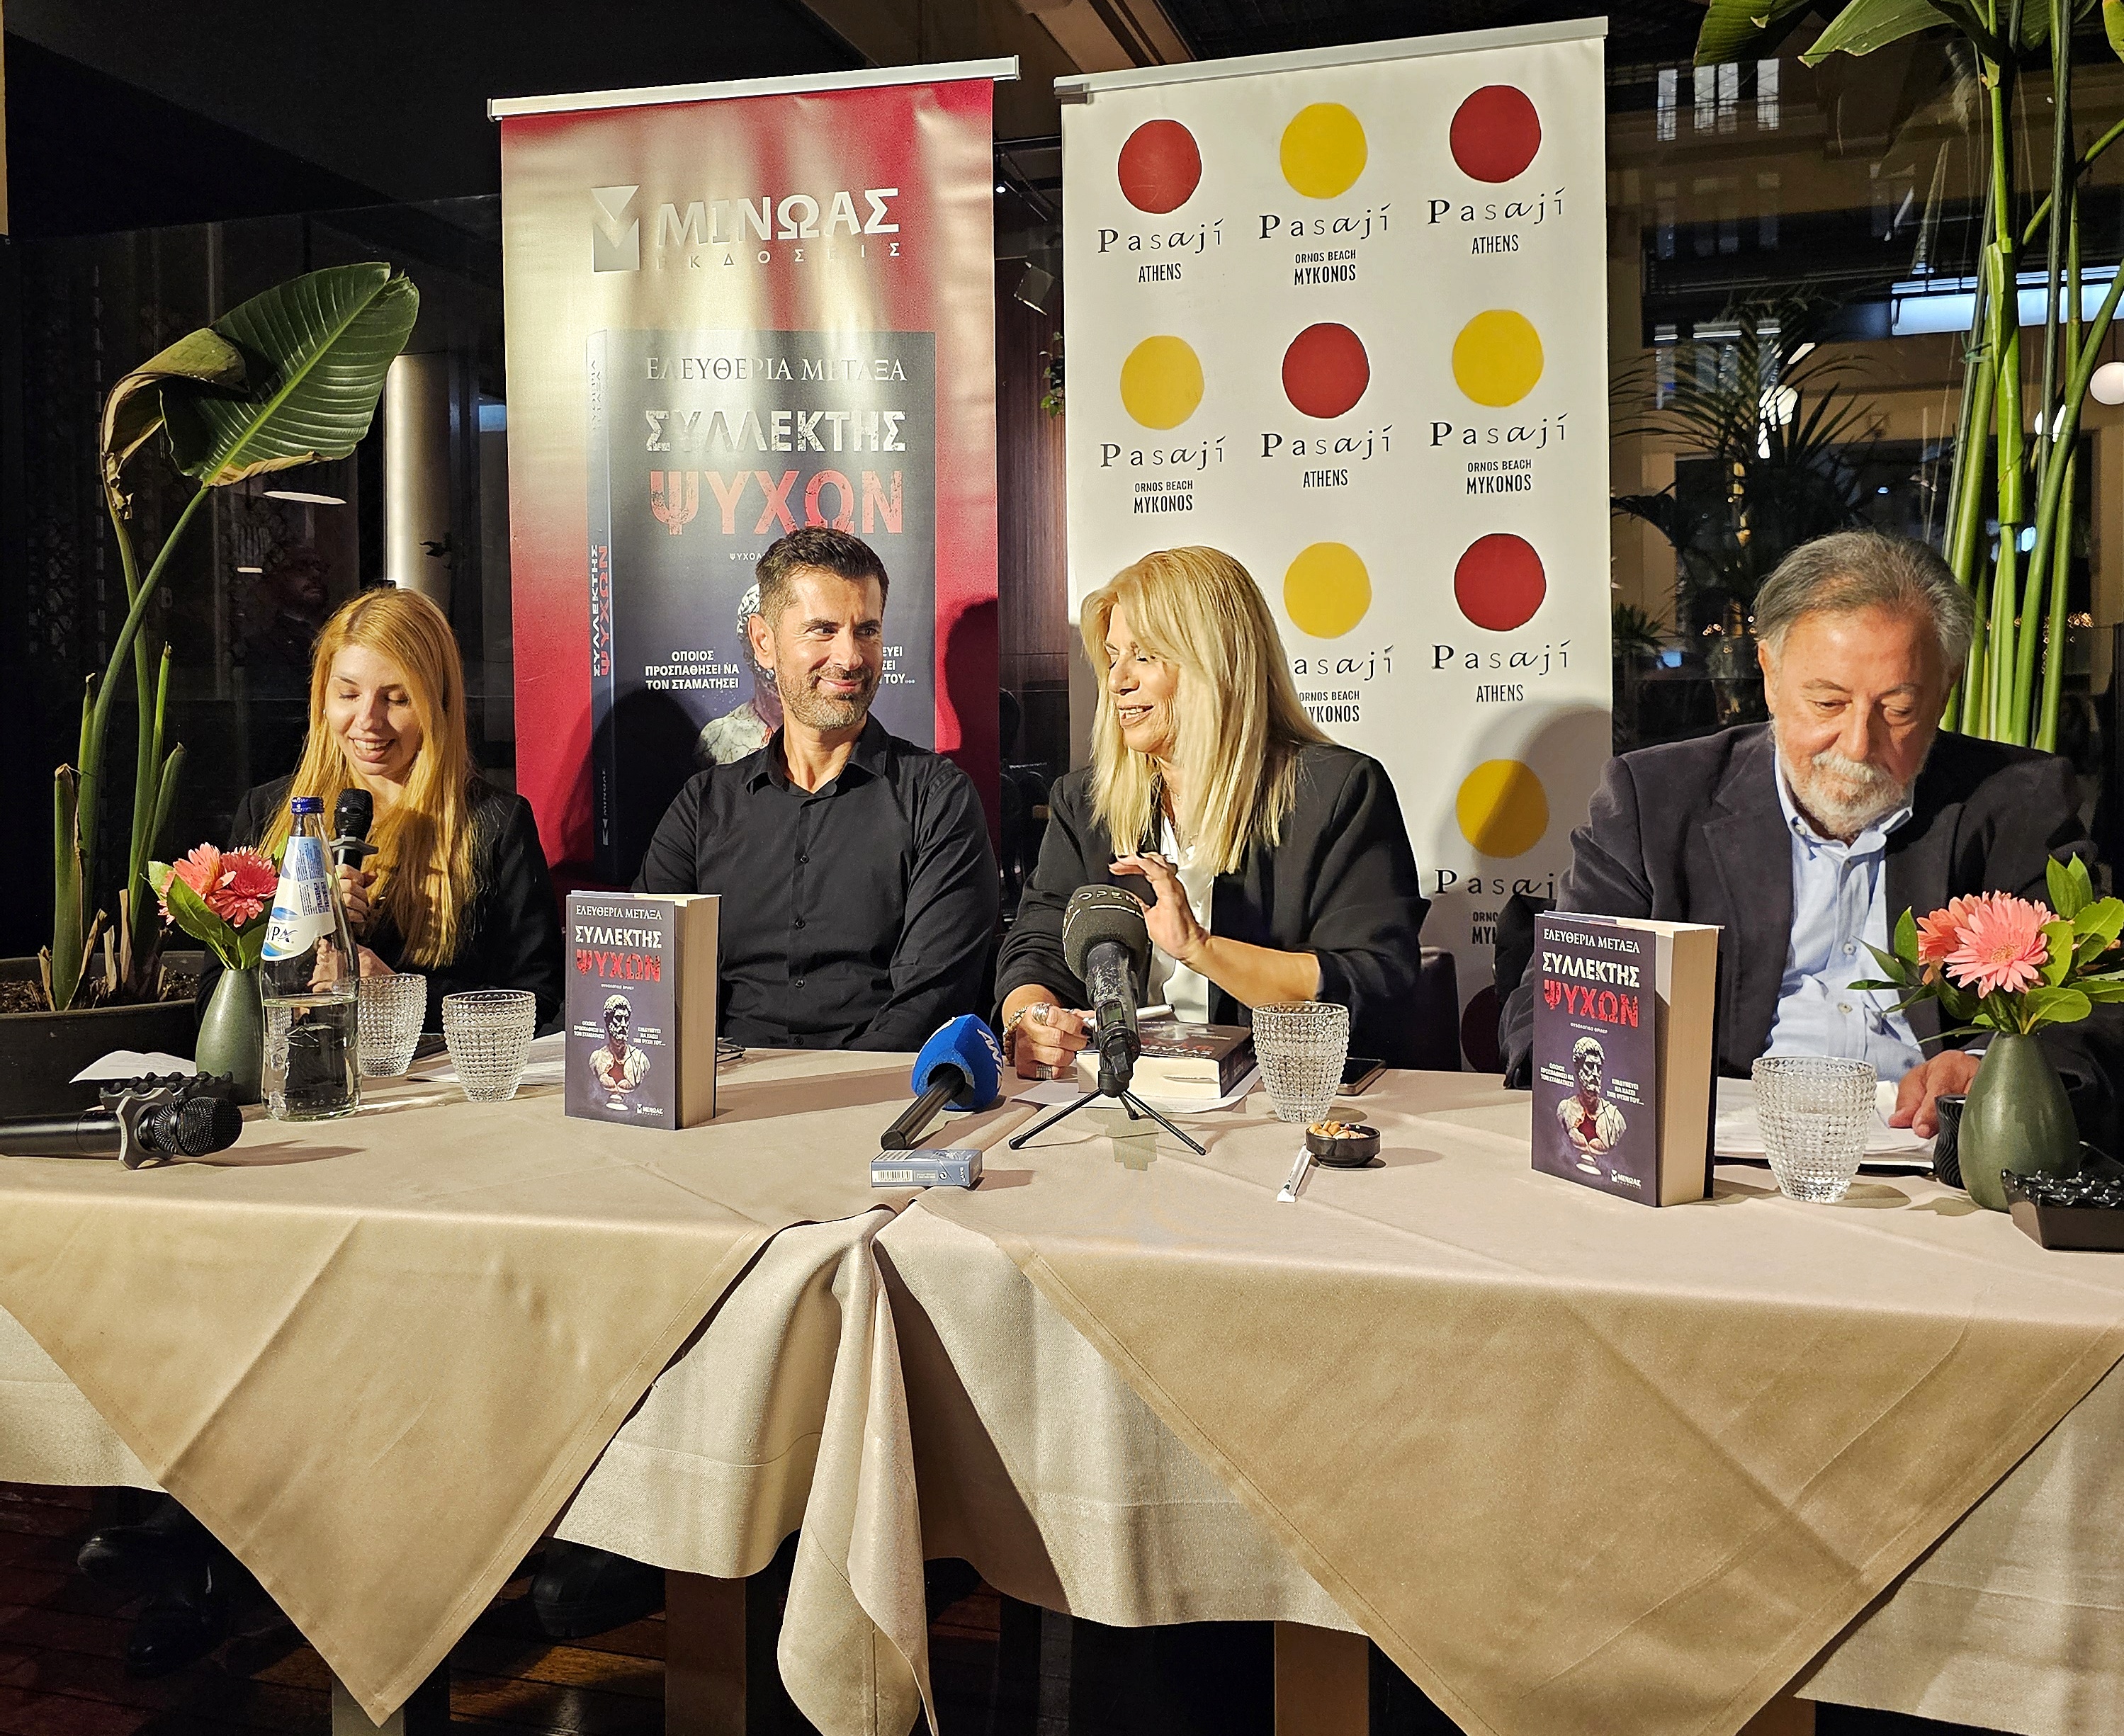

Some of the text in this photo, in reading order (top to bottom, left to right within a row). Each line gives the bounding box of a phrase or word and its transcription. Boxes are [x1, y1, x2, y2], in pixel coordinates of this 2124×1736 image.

[657, 188, 900, 246] ΜΙΝΩΑΣ
[1471, 234, 1519, 255] ATHENS
[657, 243, 900, 270] ΕΚΔΟΣΕΙΣ
[1295, 249, 1356, 264] ORNOS BEACH
[1138, 263, 1182, 283] ATHENS
[1294, 263, 1356, 286] MYKONOS
[645, 356, 908, 382] ΕΛΕΥΘΕΡΙΑ ΜΕΤΑΞΑ
[645, 409, 907, 452] ΣΥΛΛΕΚΤΗΣ
[1467, 458, 1532, 472] ORNOS BEACH
[1134, 480, 1193, 493] ORNOS BEACH
[1303, 469, 1348, 489] ATHENS
[1466, 474, 1532, 495] MYKONOS
[649, 470, 904, 535] ΨΥΧΩΝ
[1134, 494, 1193, 514] MYKONOS
[730, 552, 766, 561] ΨΥΧΟΛ
[591, 544, 601, 677] ΣΥΛΛΕΚΤΗΣ
[599, 545, 610, 676] ΨΥΧΩΝ
[671, 650, 714, 662] ΟΠΟΙΟΣ
[1294, 645, 1394, 681] asají
[645, 664, 740, 677] ΠΡΟΣΠΑΘΗΣΕΙ ΝΑ
[645, 678, 740, 691] ΤΟΝ ΣΤΑΜΑΤΗΣΕΙ
[1476, 683, 1524, 704] ATHENS
[1299, 690, 1360, 703] ORNOS BEACH
[1306, 705, 1360, 723] YKONOS
[575, 904, 662, 920] ΕΛΕΥΘΕΡΙΑ ΜΕΤΑΞΑ
[575, 925, 662, 949] ΣΥΛΛΕΚΤΗΣ
[1543, 928, 1641, 954] ΕΛΕΥΘΕΡΙΑ ΜΕΤΑΞΑ
[576, 948, 661, 982] ΨΥΧΩΝ
[1542, 951, 1641, 988] ΣΥΛΛΕΚΤΗΣ
[1543, 979, 1639, 1028] ΨΥΧΩΝ
